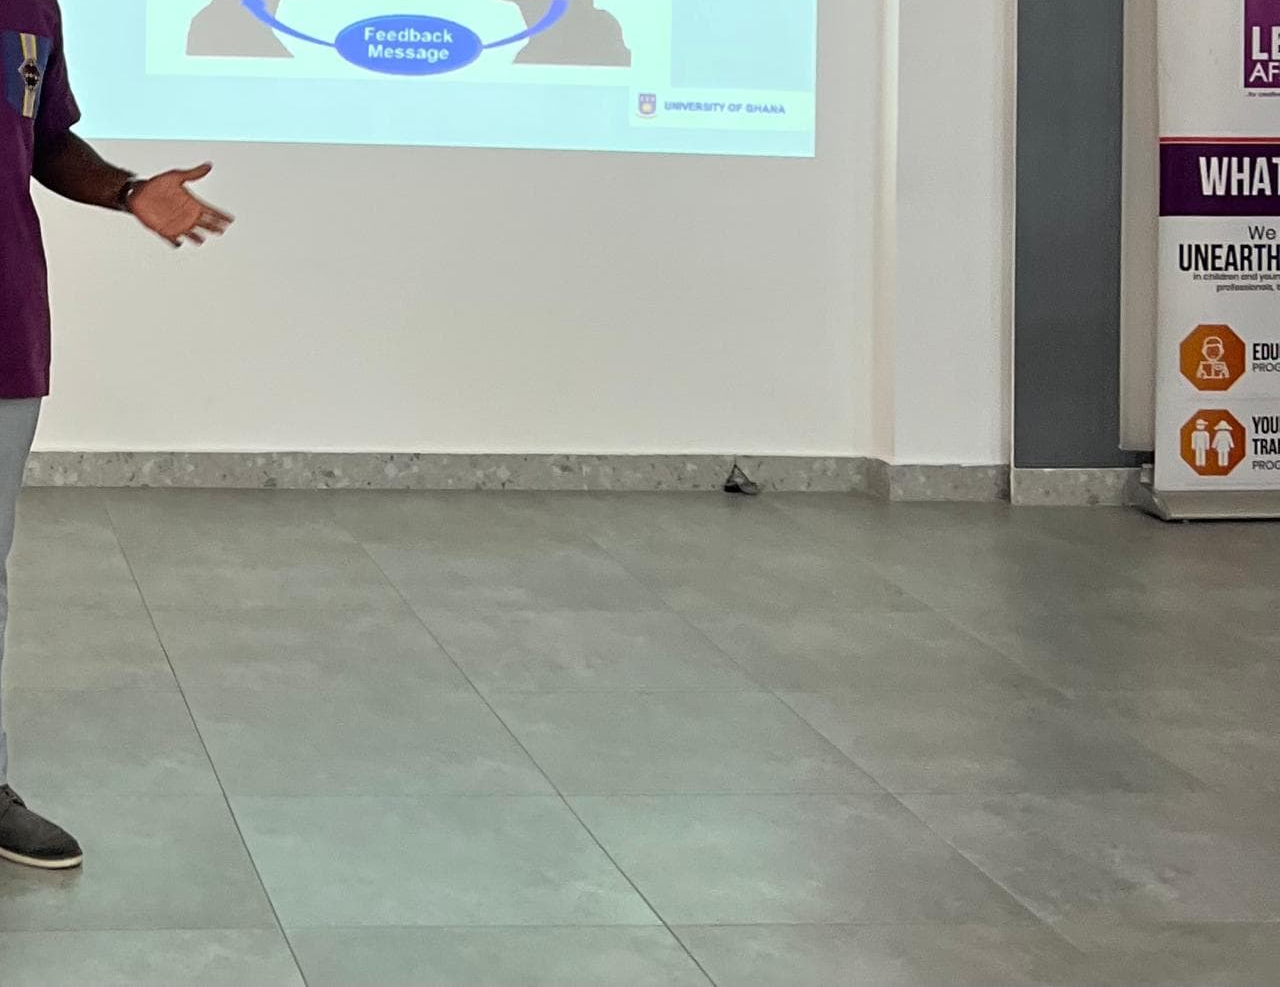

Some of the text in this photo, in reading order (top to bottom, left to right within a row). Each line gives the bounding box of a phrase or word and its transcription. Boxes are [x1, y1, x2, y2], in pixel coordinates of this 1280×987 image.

[364, 27, 453, 44] Feedback
[367, 44, 450, 63] Message
[664, 101, 786, 114] UNIVERSITY OF GHANA
[1248, 225, 1277, 240] We
[1179, 244, 1280, 272] UNEARTH
[1253, 343, 1279, 360] EDU
[1252, 416, 1279, 434] YOU
